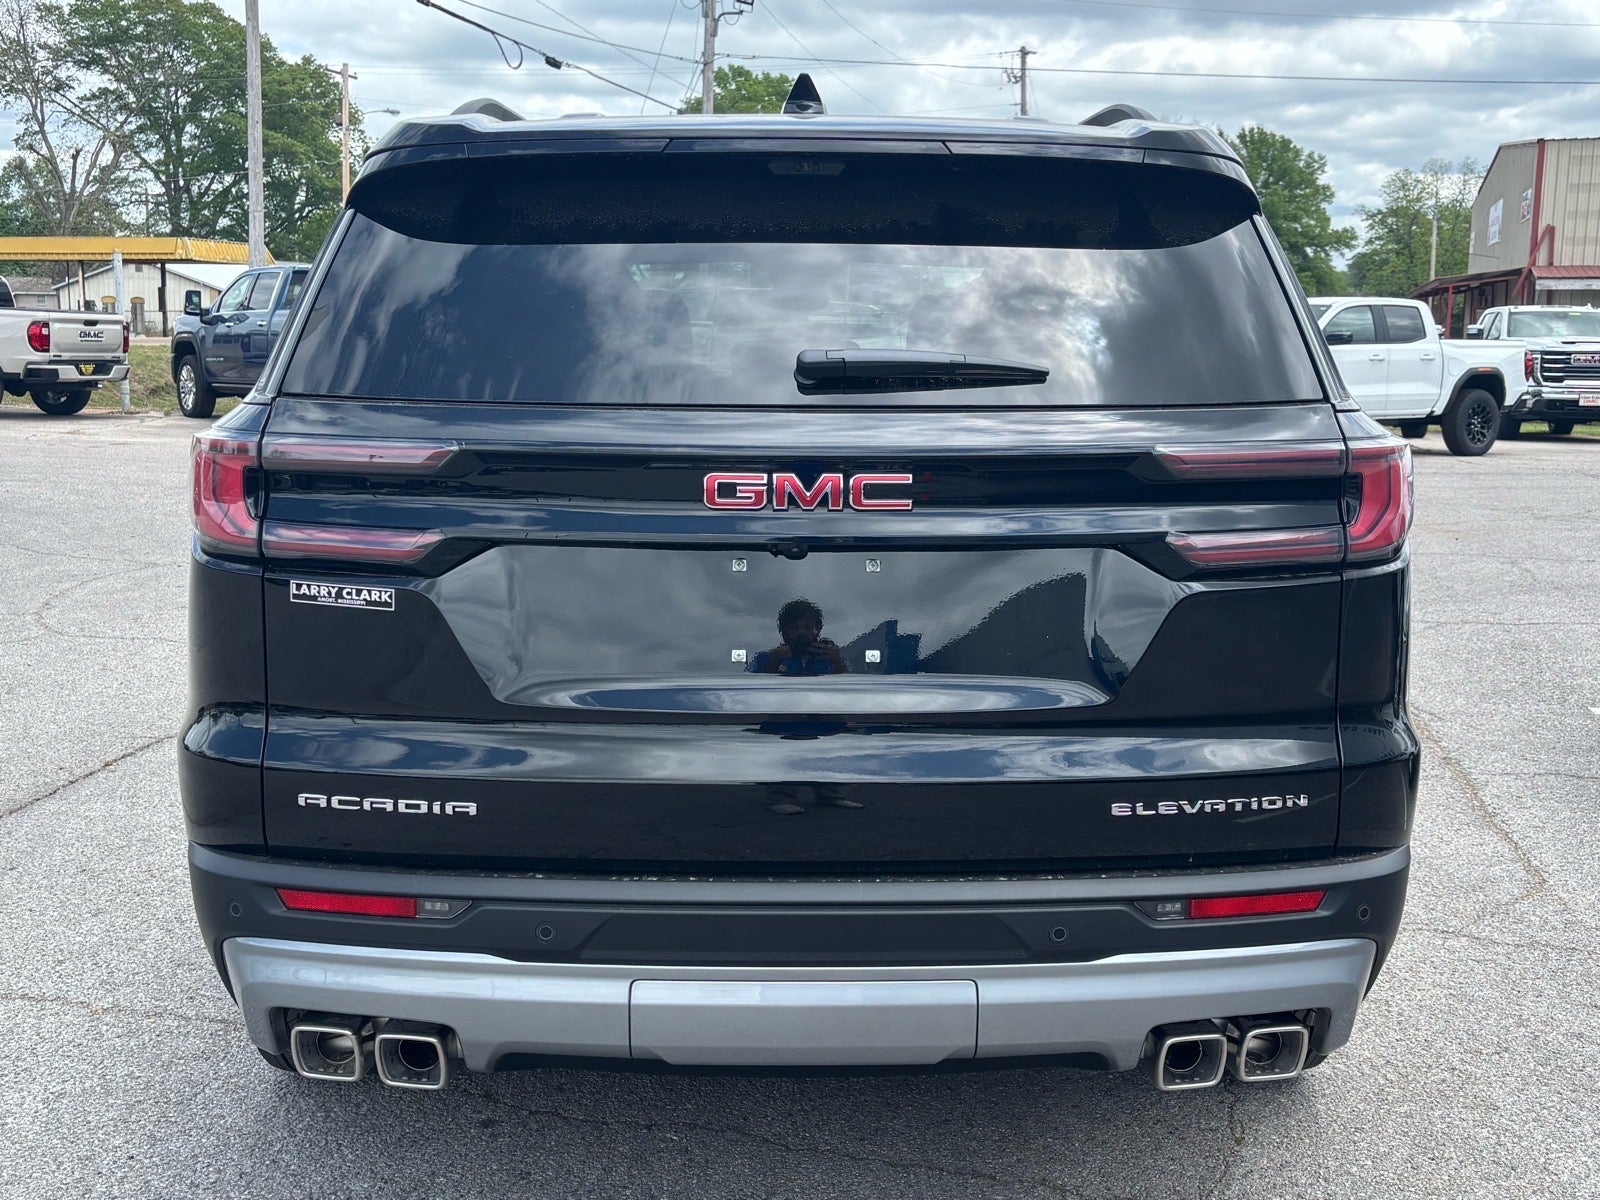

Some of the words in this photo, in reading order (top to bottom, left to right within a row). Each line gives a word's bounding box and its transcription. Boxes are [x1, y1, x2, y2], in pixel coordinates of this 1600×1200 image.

[79, 331, 105, 339] GMC
[703, 472, 913, 510] GMC
[292, 583, 339, 598] LARRY
[342, 588, 393, 603] CLARK
[297, 793, 478, 816] ACADIA
[1110, 794, 1310, 816] ELEVATION
